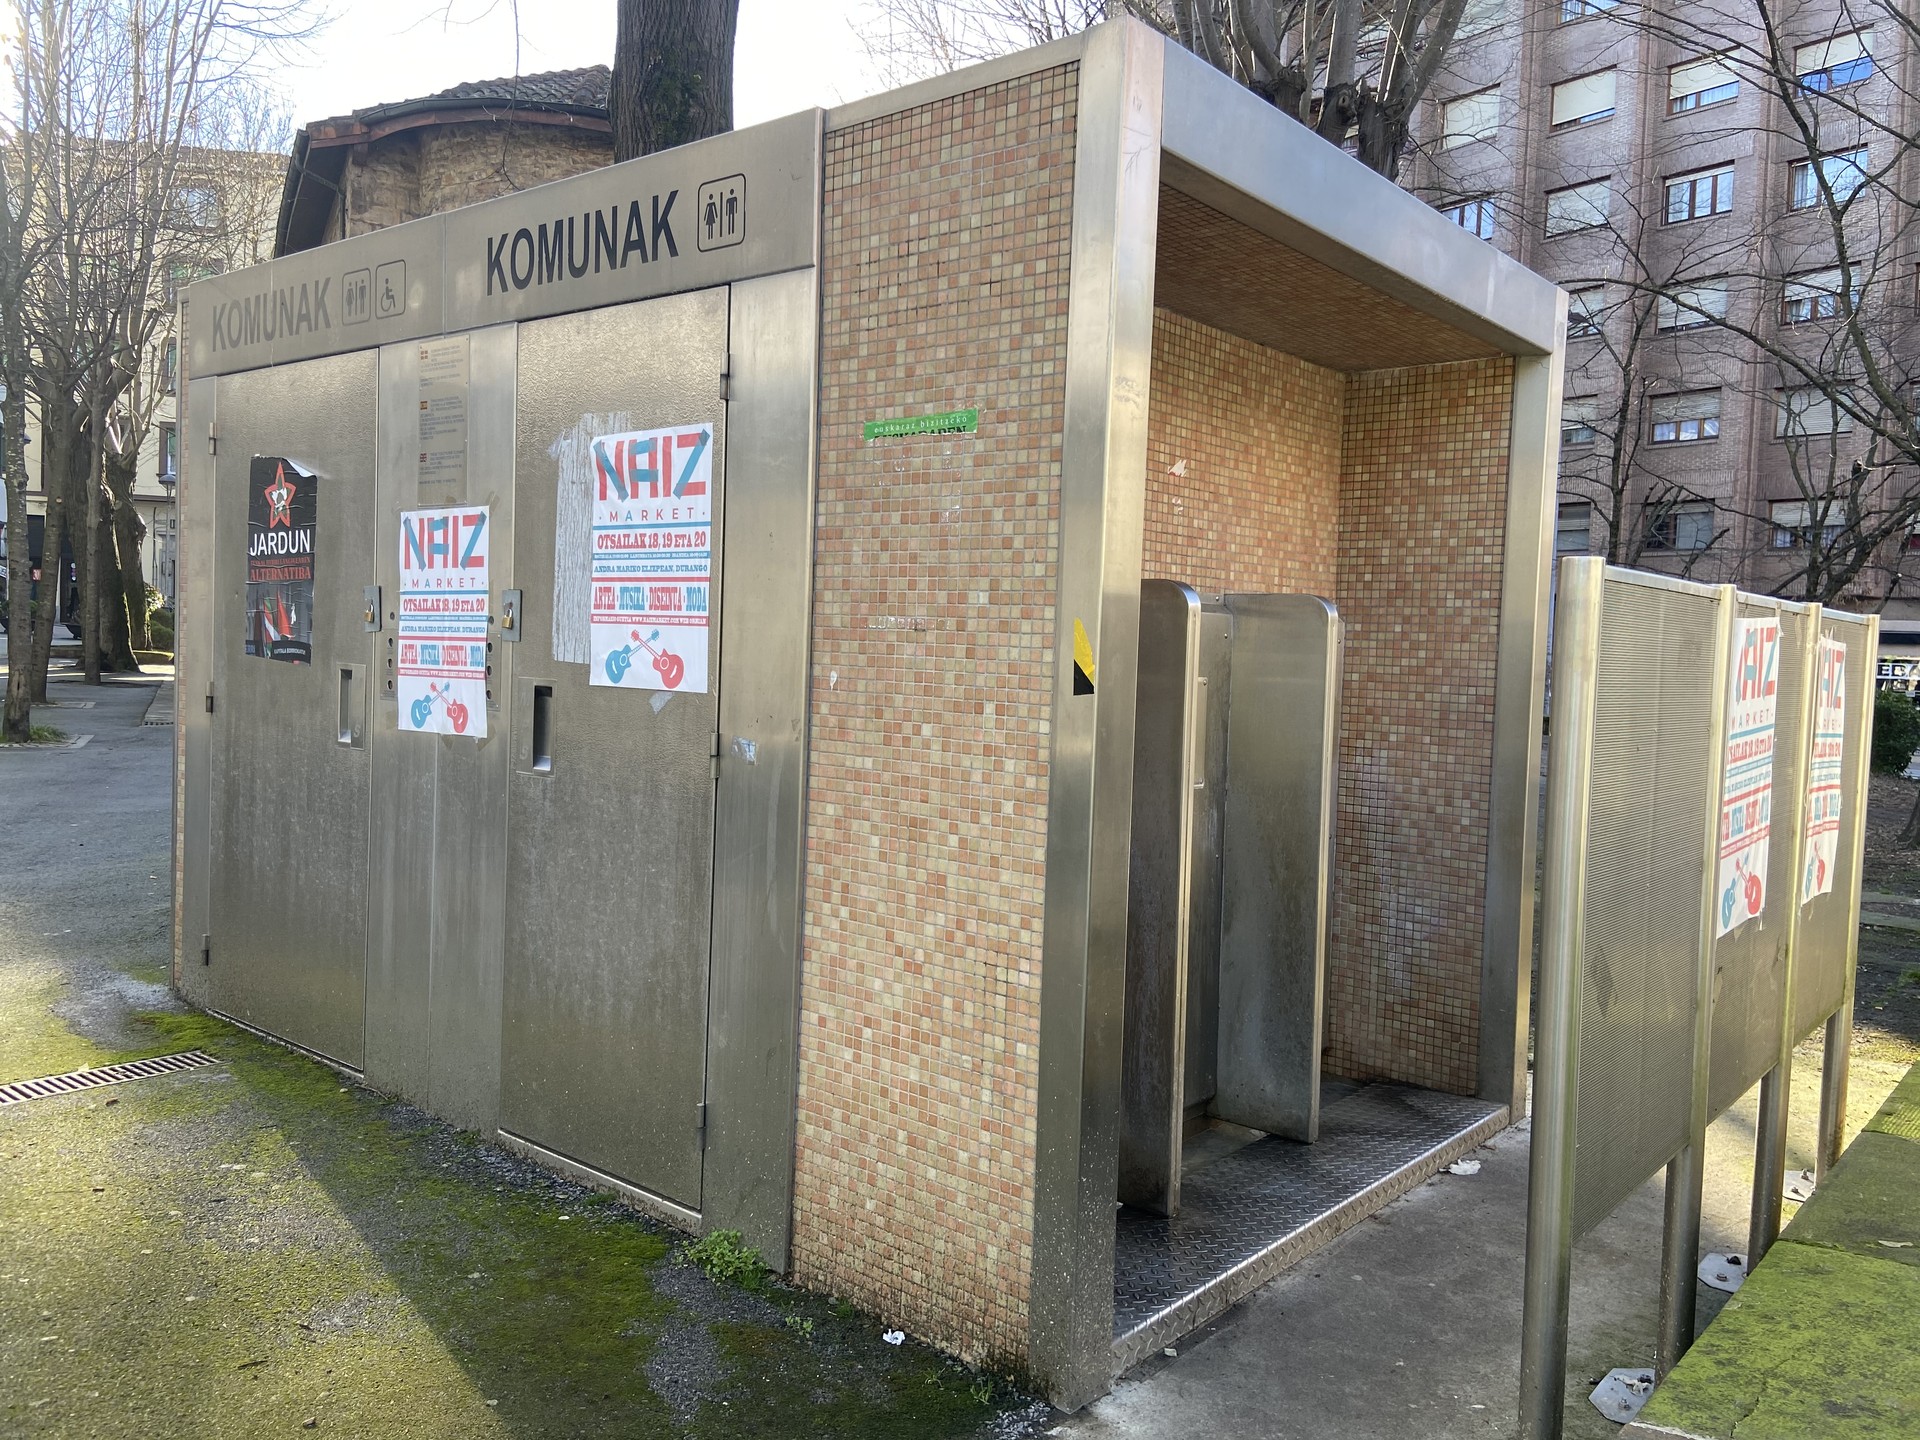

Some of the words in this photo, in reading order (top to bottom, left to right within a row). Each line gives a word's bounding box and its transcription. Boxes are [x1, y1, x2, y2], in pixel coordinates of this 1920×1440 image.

[487, 189, 679, 296] KOMUNAK
[212, 277, 331, 352] KOMUNAK
[874, 423, 915, 433] euskaraz
[593, 428, 710, 502] NAIZ
[609, 507, 694, 522] MARKET
[250, 528, 310, 556] JARDUN
[403, 511, 487, 572] NAIZ
[597, 533, 647, 549] OTSAILAK
[662, 531, 672, 548] 19
[674, 534, 692, 548] ETA
[694, 531, 706, 547] 20
[250, 567, 312, 582] ALTERNATIBA
[594, 565, 615, 573] ANDRA
[676, 564, 708, 572] DURANGO
[412, 577, 475, 588] MARKET
[403, 598, 441, 612] OTSAILAK
[452, 598, 460, 612] 19
[460, 600, 475, 612] ETA
[476, 598, 485, 612] 20
[593, 587, 616, 610] ARTEA
[619, 587, 645, 610] MUSIKA
[686, 587, 707, 611] MODA
